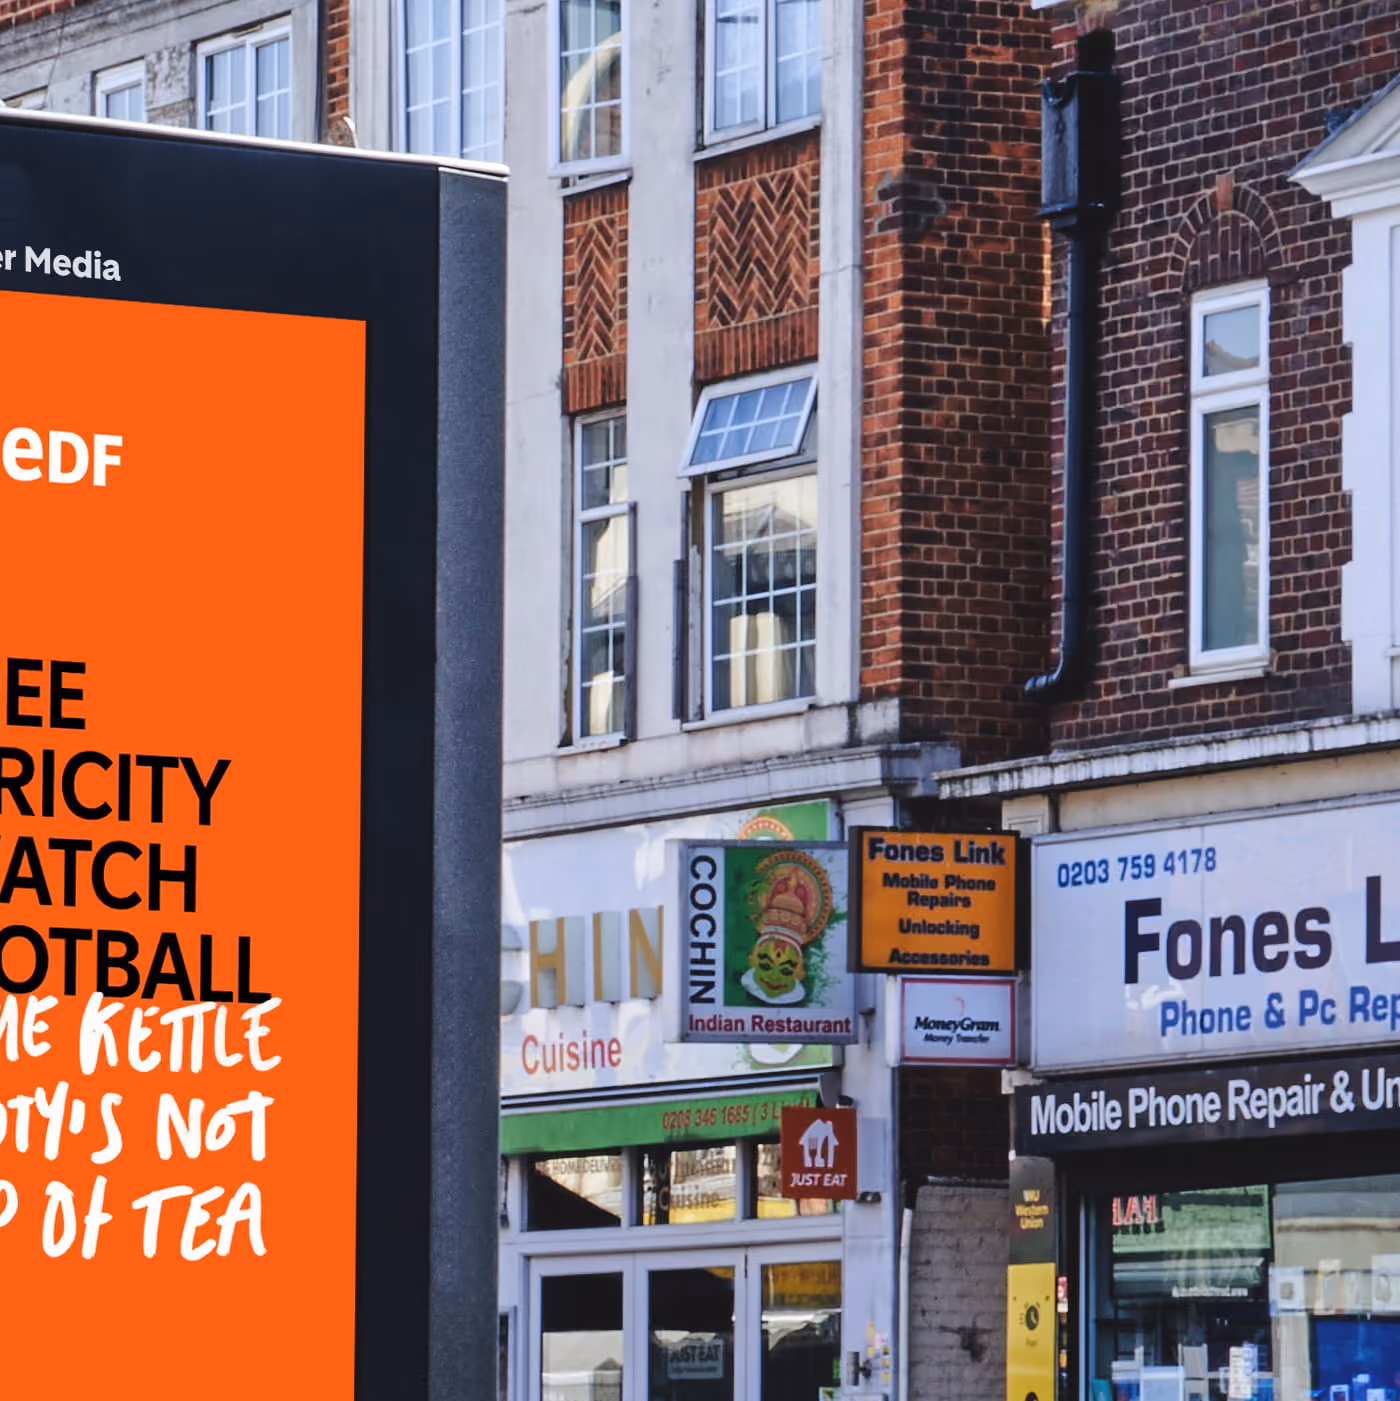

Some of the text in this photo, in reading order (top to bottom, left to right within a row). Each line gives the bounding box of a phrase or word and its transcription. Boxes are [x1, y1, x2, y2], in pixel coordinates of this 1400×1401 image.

[25, 246, 121, 281] Media
[868, 837, 1005, 865] Fones Link
[1058, 848, 1217, 887] 0203 759 4178
[883, 873, 996, 891] Mobile Phone
[908, 893, 971, 910] Repairs
[689, 855, 717, 1004] COCHIN
[899, 919, 980, 939] Unlocking
[1125, 898, 1332, 984] Fones
[889, 948, 990, 965] Accessories
[689, 1015, 851, 1034] Indian Restaurant
[1161, 1000, 1251, 1037] Phone
[1264, 992, 1285, 1029] &
[1299, 989, 1336, 1026] Pc
[79, 992, 282, 1074] KETTLE
[522, 1032, 622, 1074] Cuisine
[1031, 1090, 1122, 1135] Mobile
[1129, 1086, 1221, 1128] Phone
[1228, 1074, 1325, 1129] Repair
[1330, 1071, 1354, 1112] &
[156, 1090, 274, 1162] NOT
[790, 1173, 847, 1187] JUST EAT
[42, 1175, 112, 1259] OF
[132, 1182, 266, 1261] TEA
